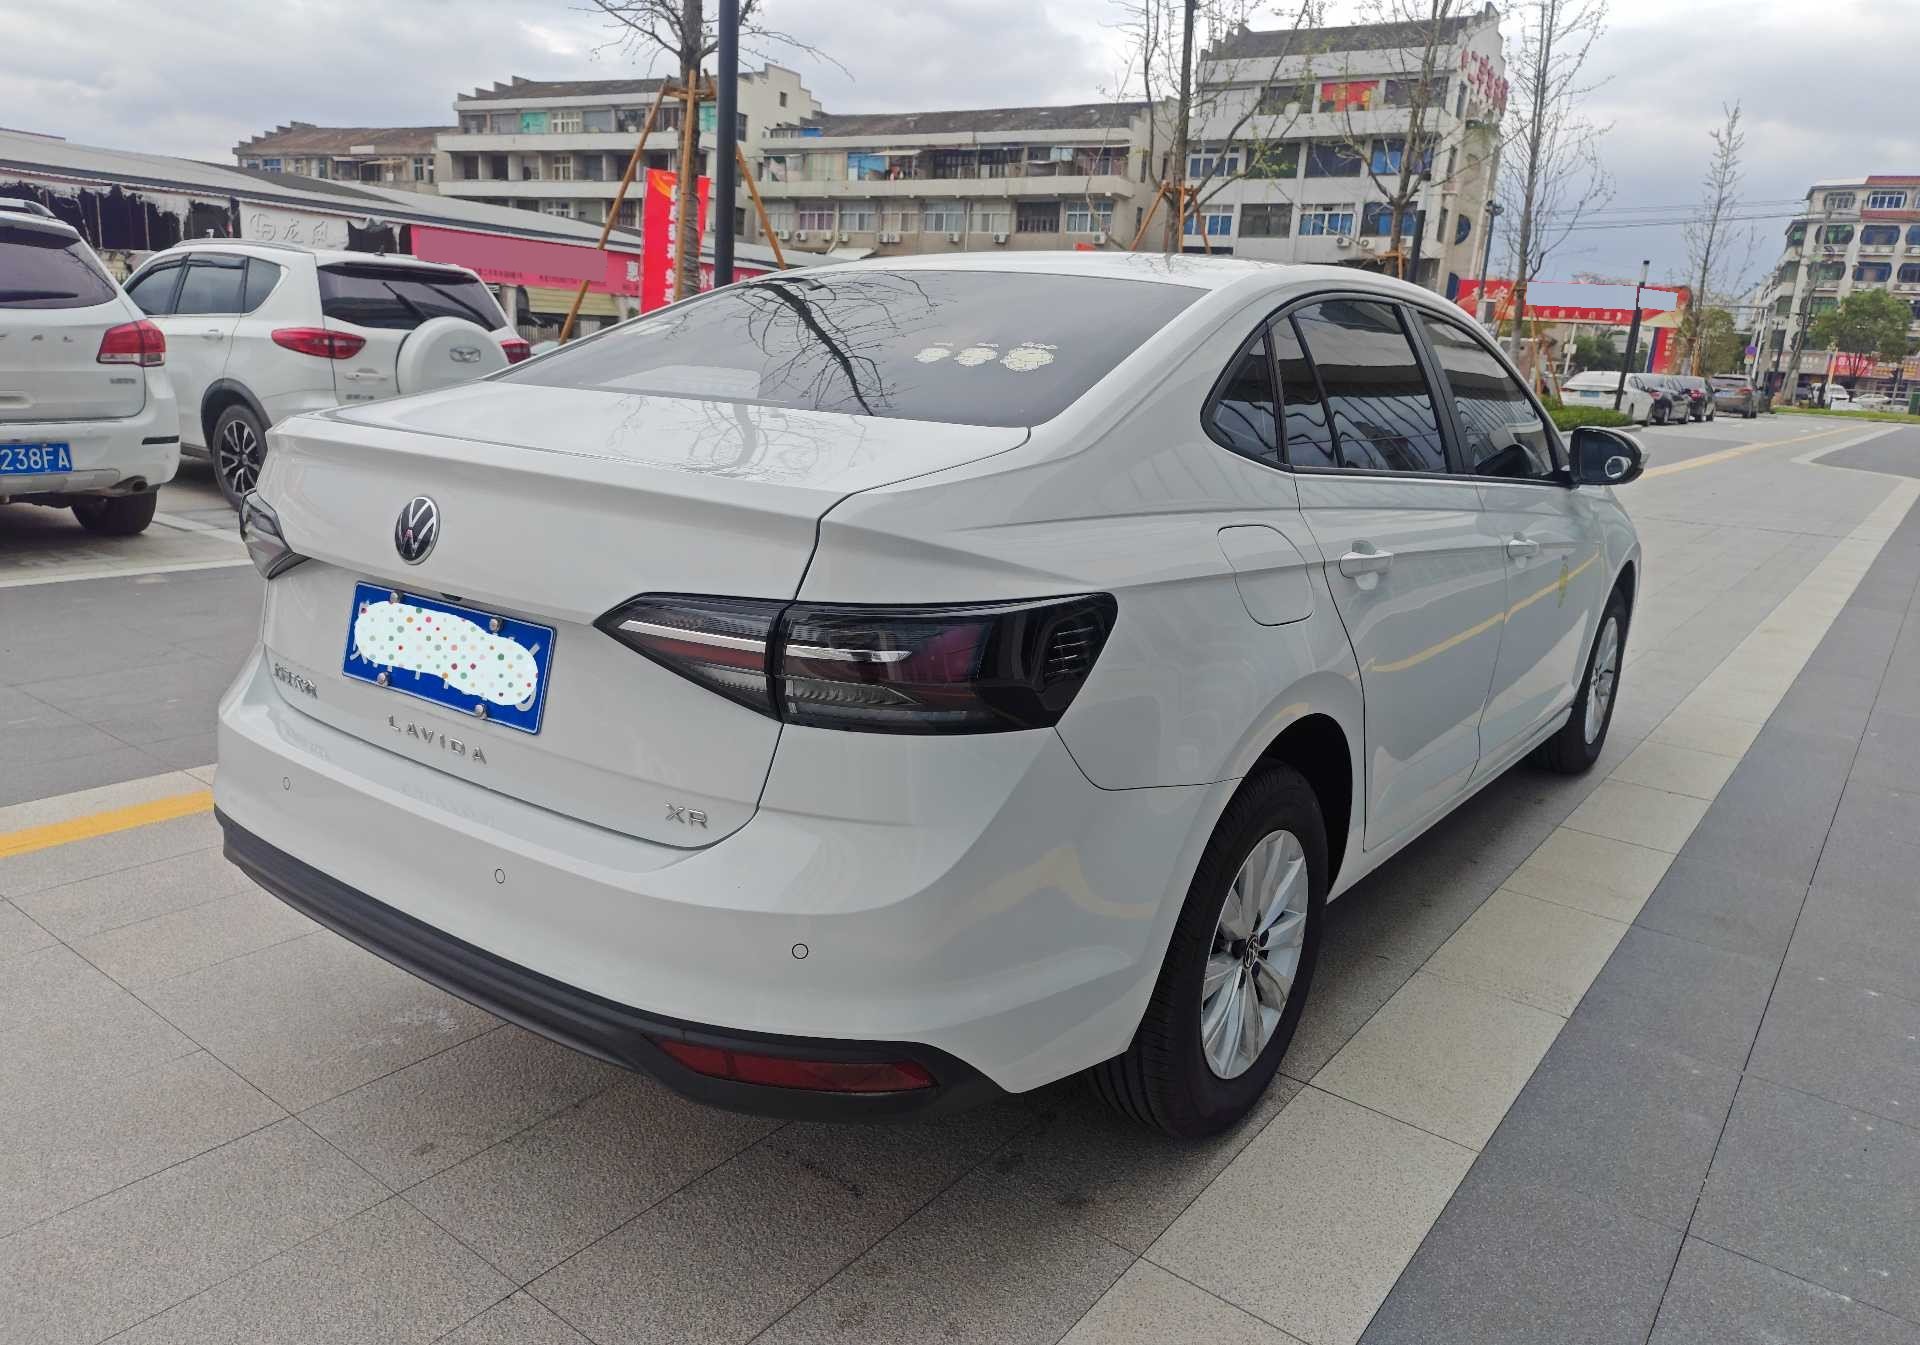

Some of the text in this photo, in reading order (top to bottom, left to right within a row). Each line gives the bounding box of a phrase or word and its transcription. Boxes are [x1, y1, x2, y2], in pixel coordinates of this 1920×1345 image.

[0, 447, 70, 471] 238FA
[387, 713, 487, 765] LAVIDA
[665, 801, 708, 829] XR
